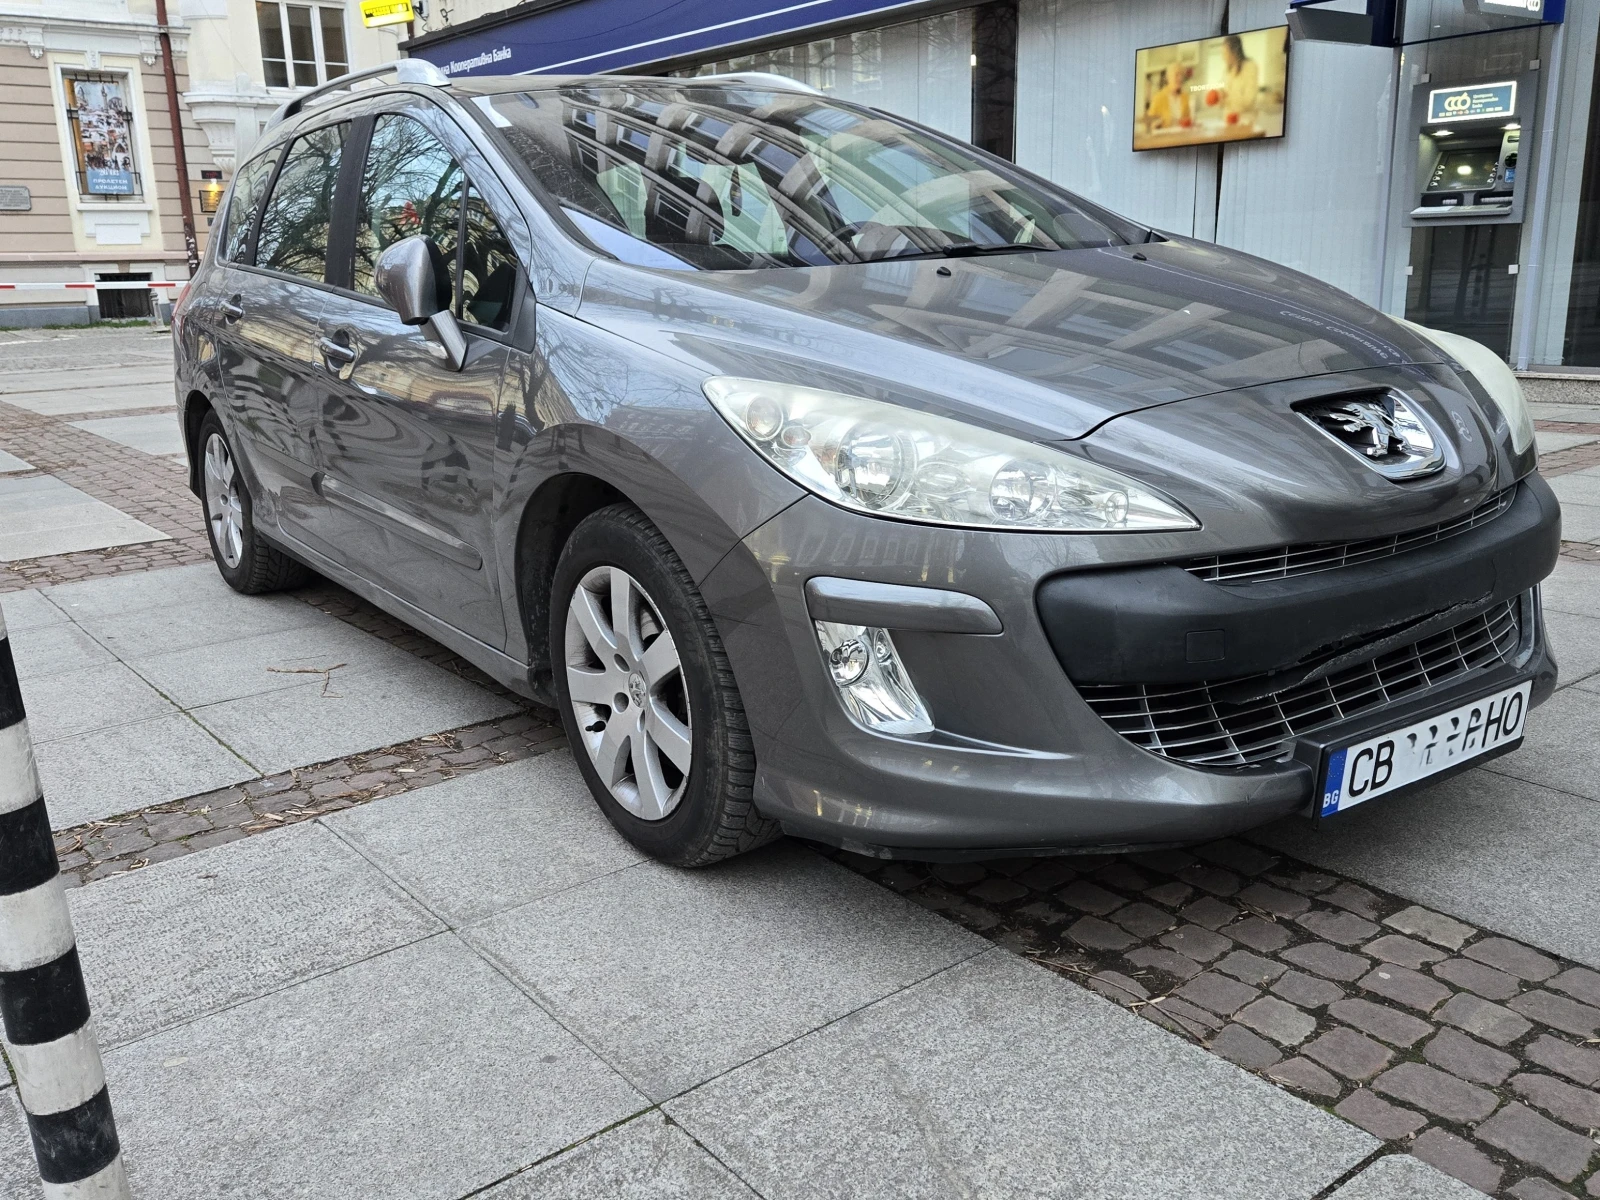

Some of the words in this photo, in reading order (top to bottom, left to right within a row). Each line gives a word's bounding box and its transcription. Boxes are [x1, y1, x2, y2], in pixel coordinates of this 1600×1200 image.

[450, 52, 493, 72] Кооперативна
[492, 46, 512, 62] Банка
[1322, 790, 1340, 808] BG
[1348, 740, 1395, 798] CB
